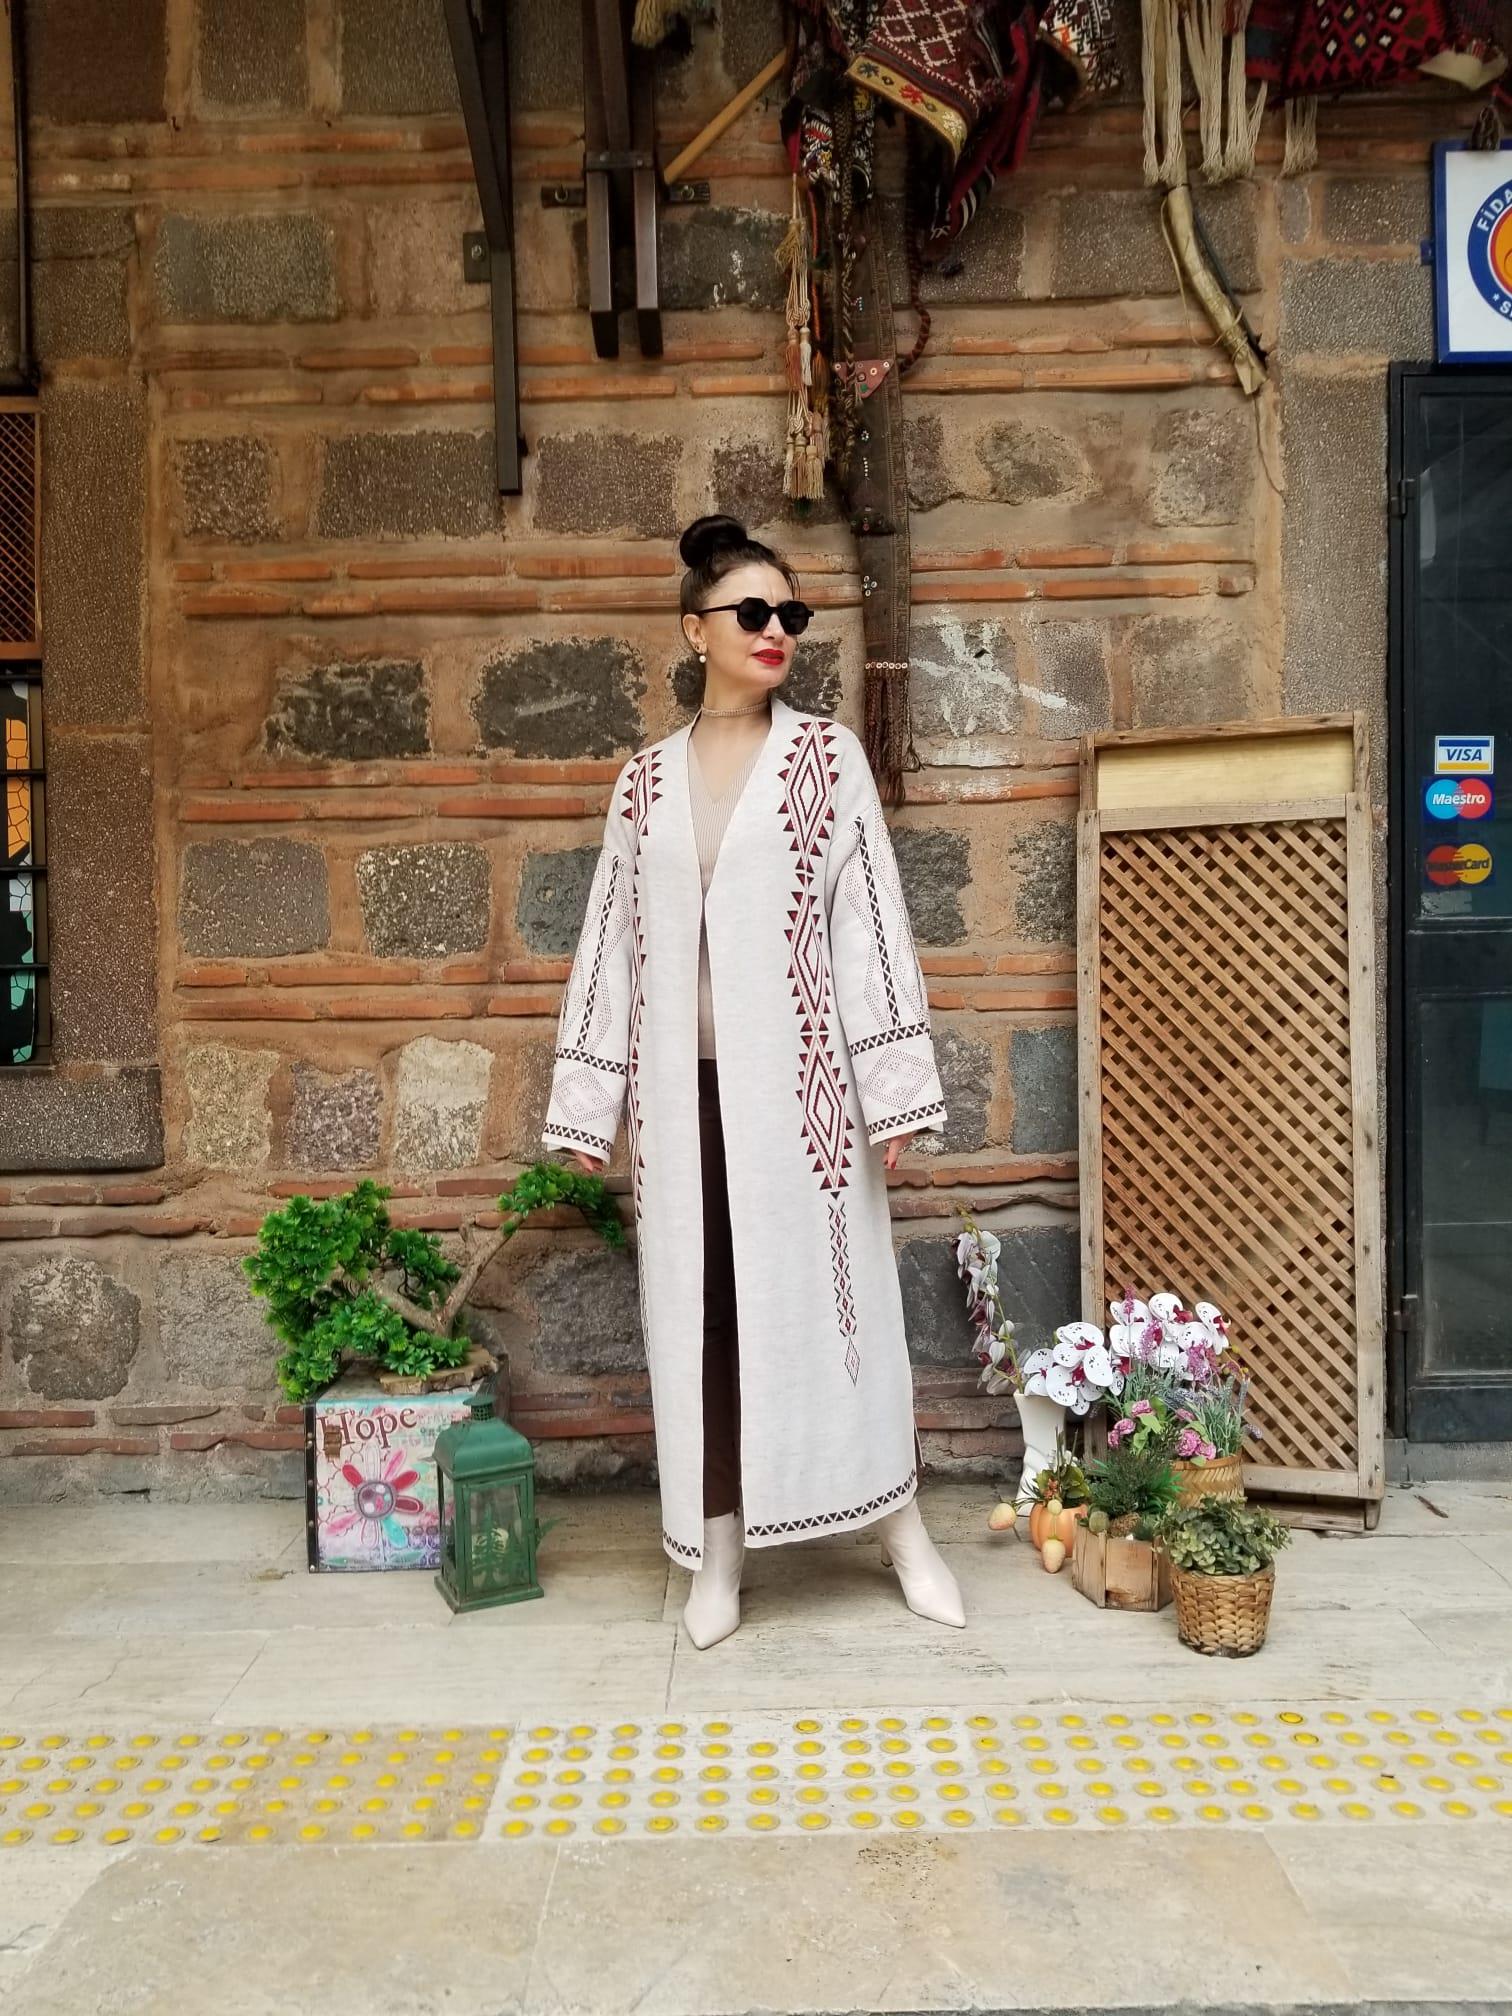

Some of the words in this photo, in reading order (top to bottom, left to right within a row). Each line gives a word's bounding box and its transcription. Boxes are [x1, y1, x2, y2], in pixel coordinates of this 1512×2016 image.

[1446, 748, 1482, 761] VISA
[1432, 793, 1485, 805] Maestro
[317, 1406, 417, 1450] Hope
